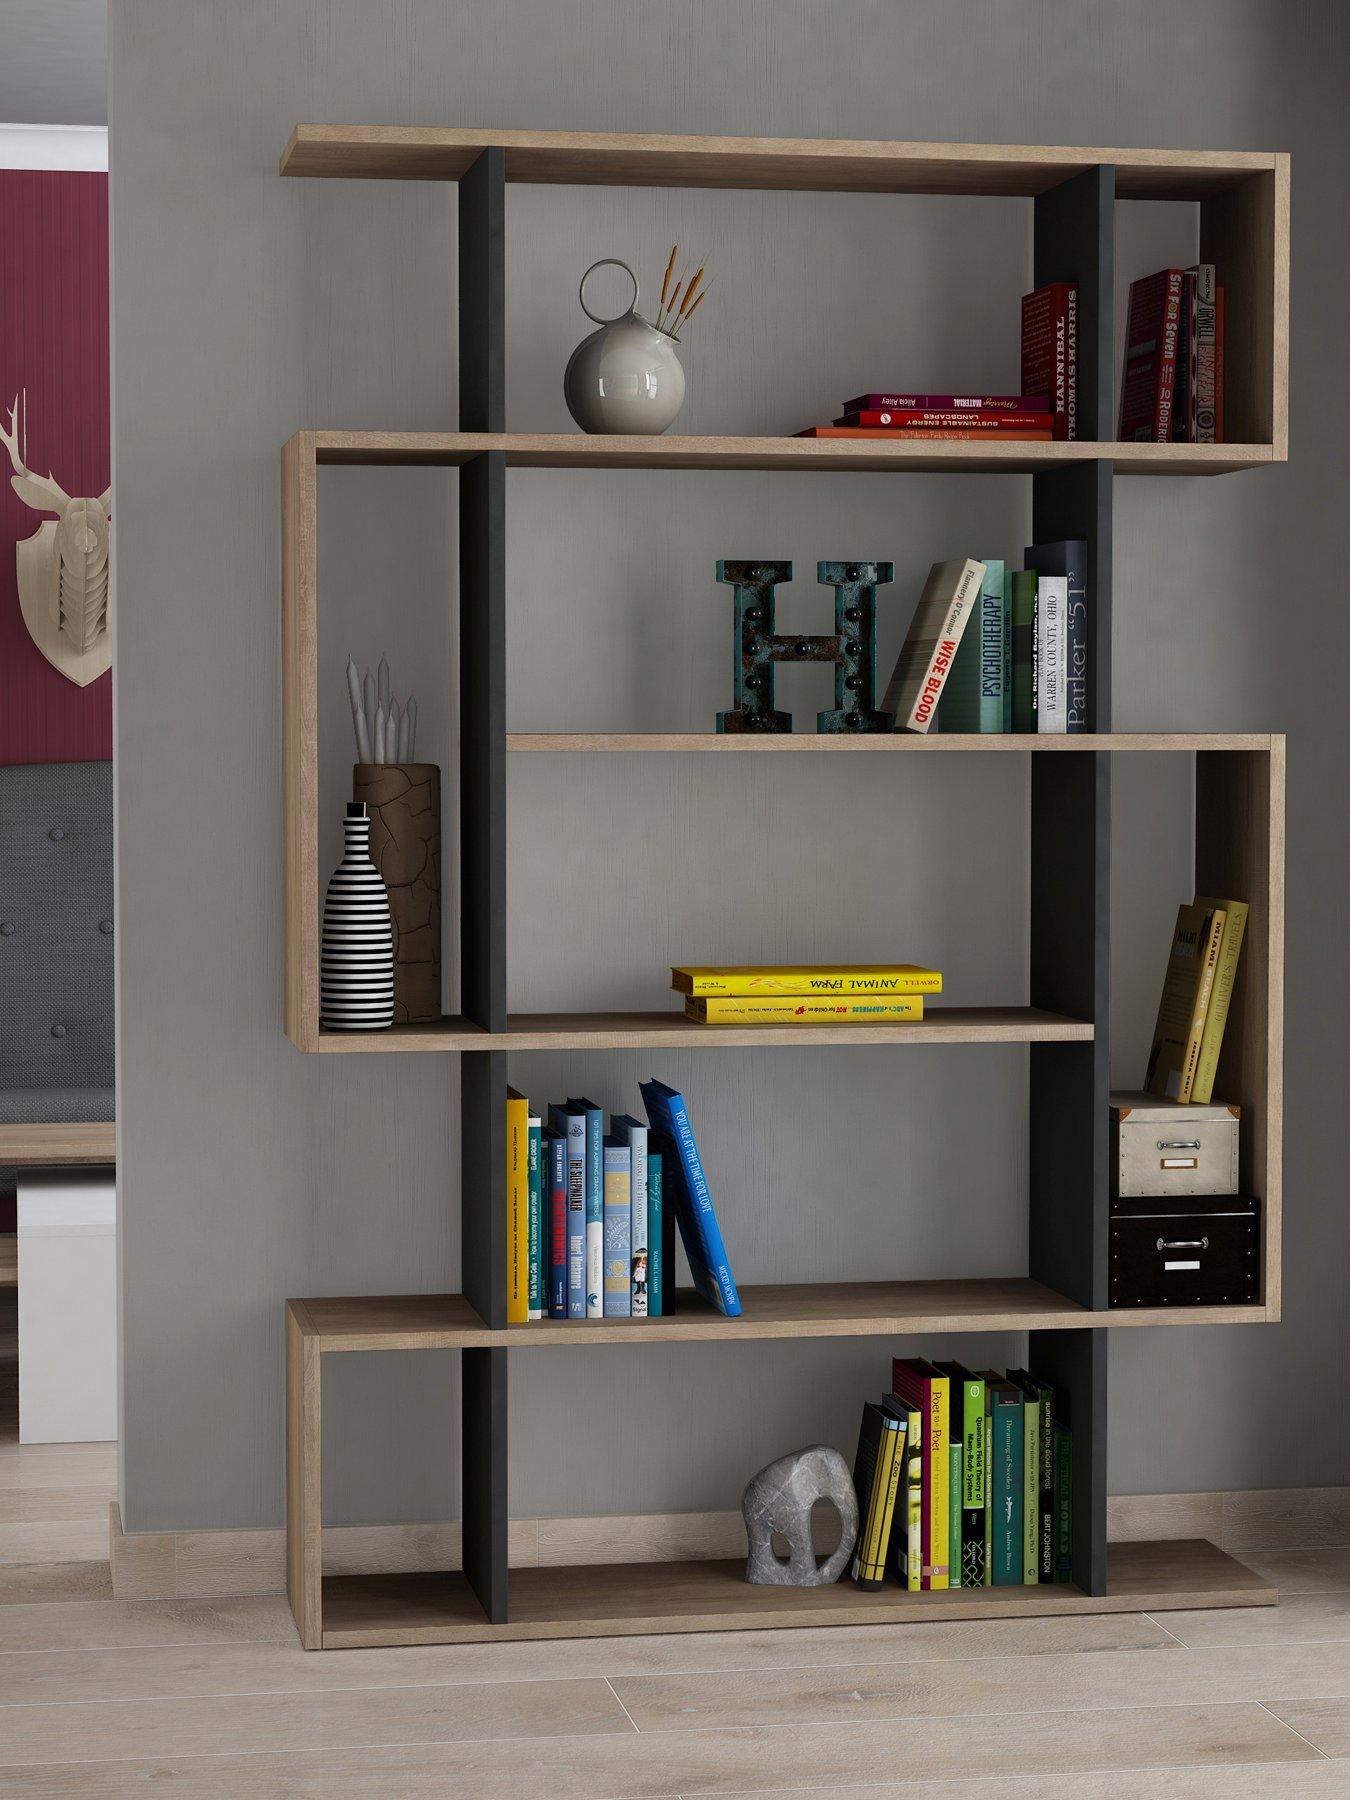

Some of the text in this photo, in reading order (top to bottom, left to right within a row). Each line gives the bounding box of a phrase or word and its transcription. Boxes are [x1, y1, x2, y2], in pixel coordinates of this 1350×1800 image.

[1199, 308, 1215, 339] ORWELL
[1056, 316, 1065, 413] HANNIBAL
[1068, 290, 1077, 440] THOMAS HARRIS
[953, 398, 982, 408] MATERIAL
[946, 569, 975, 636] Flannery O'Connor
[982, 593, 1001, 697] PSYCHOTHERAPY
[1047, 595, 1058, 711] WARREN COUNTY, OHIO
[915, 640, 956, 723] WISE BLOOD
[1067, 638, 1086, 727] Parker
[810, 980, 844, 989] FARM
[848, 978, 900, 989] ANIMAL
[1200, 921, 1221, 1009] MIAMI BEACH
[1213, 912, 1242, 1022] GULLIVER'S TRAVELS
[570, 1158, 583, 1212] THE SLEEPWALKER
[676, 1109, 712, 1213] YOU ARE AT THE TIME FOR LOVE
[570, 1235, 584, 1255] Robert
[932, 1391, 942, 1414] Poet
[932, 1430, 942, 1452] Poet
[966, 1433, 974, 1502] Many-Body Systems
[888, 1480, 897, 1506] STORY
[975, 1469, 983, 1492] Theory
[976, 1493, 983, 1502] of
